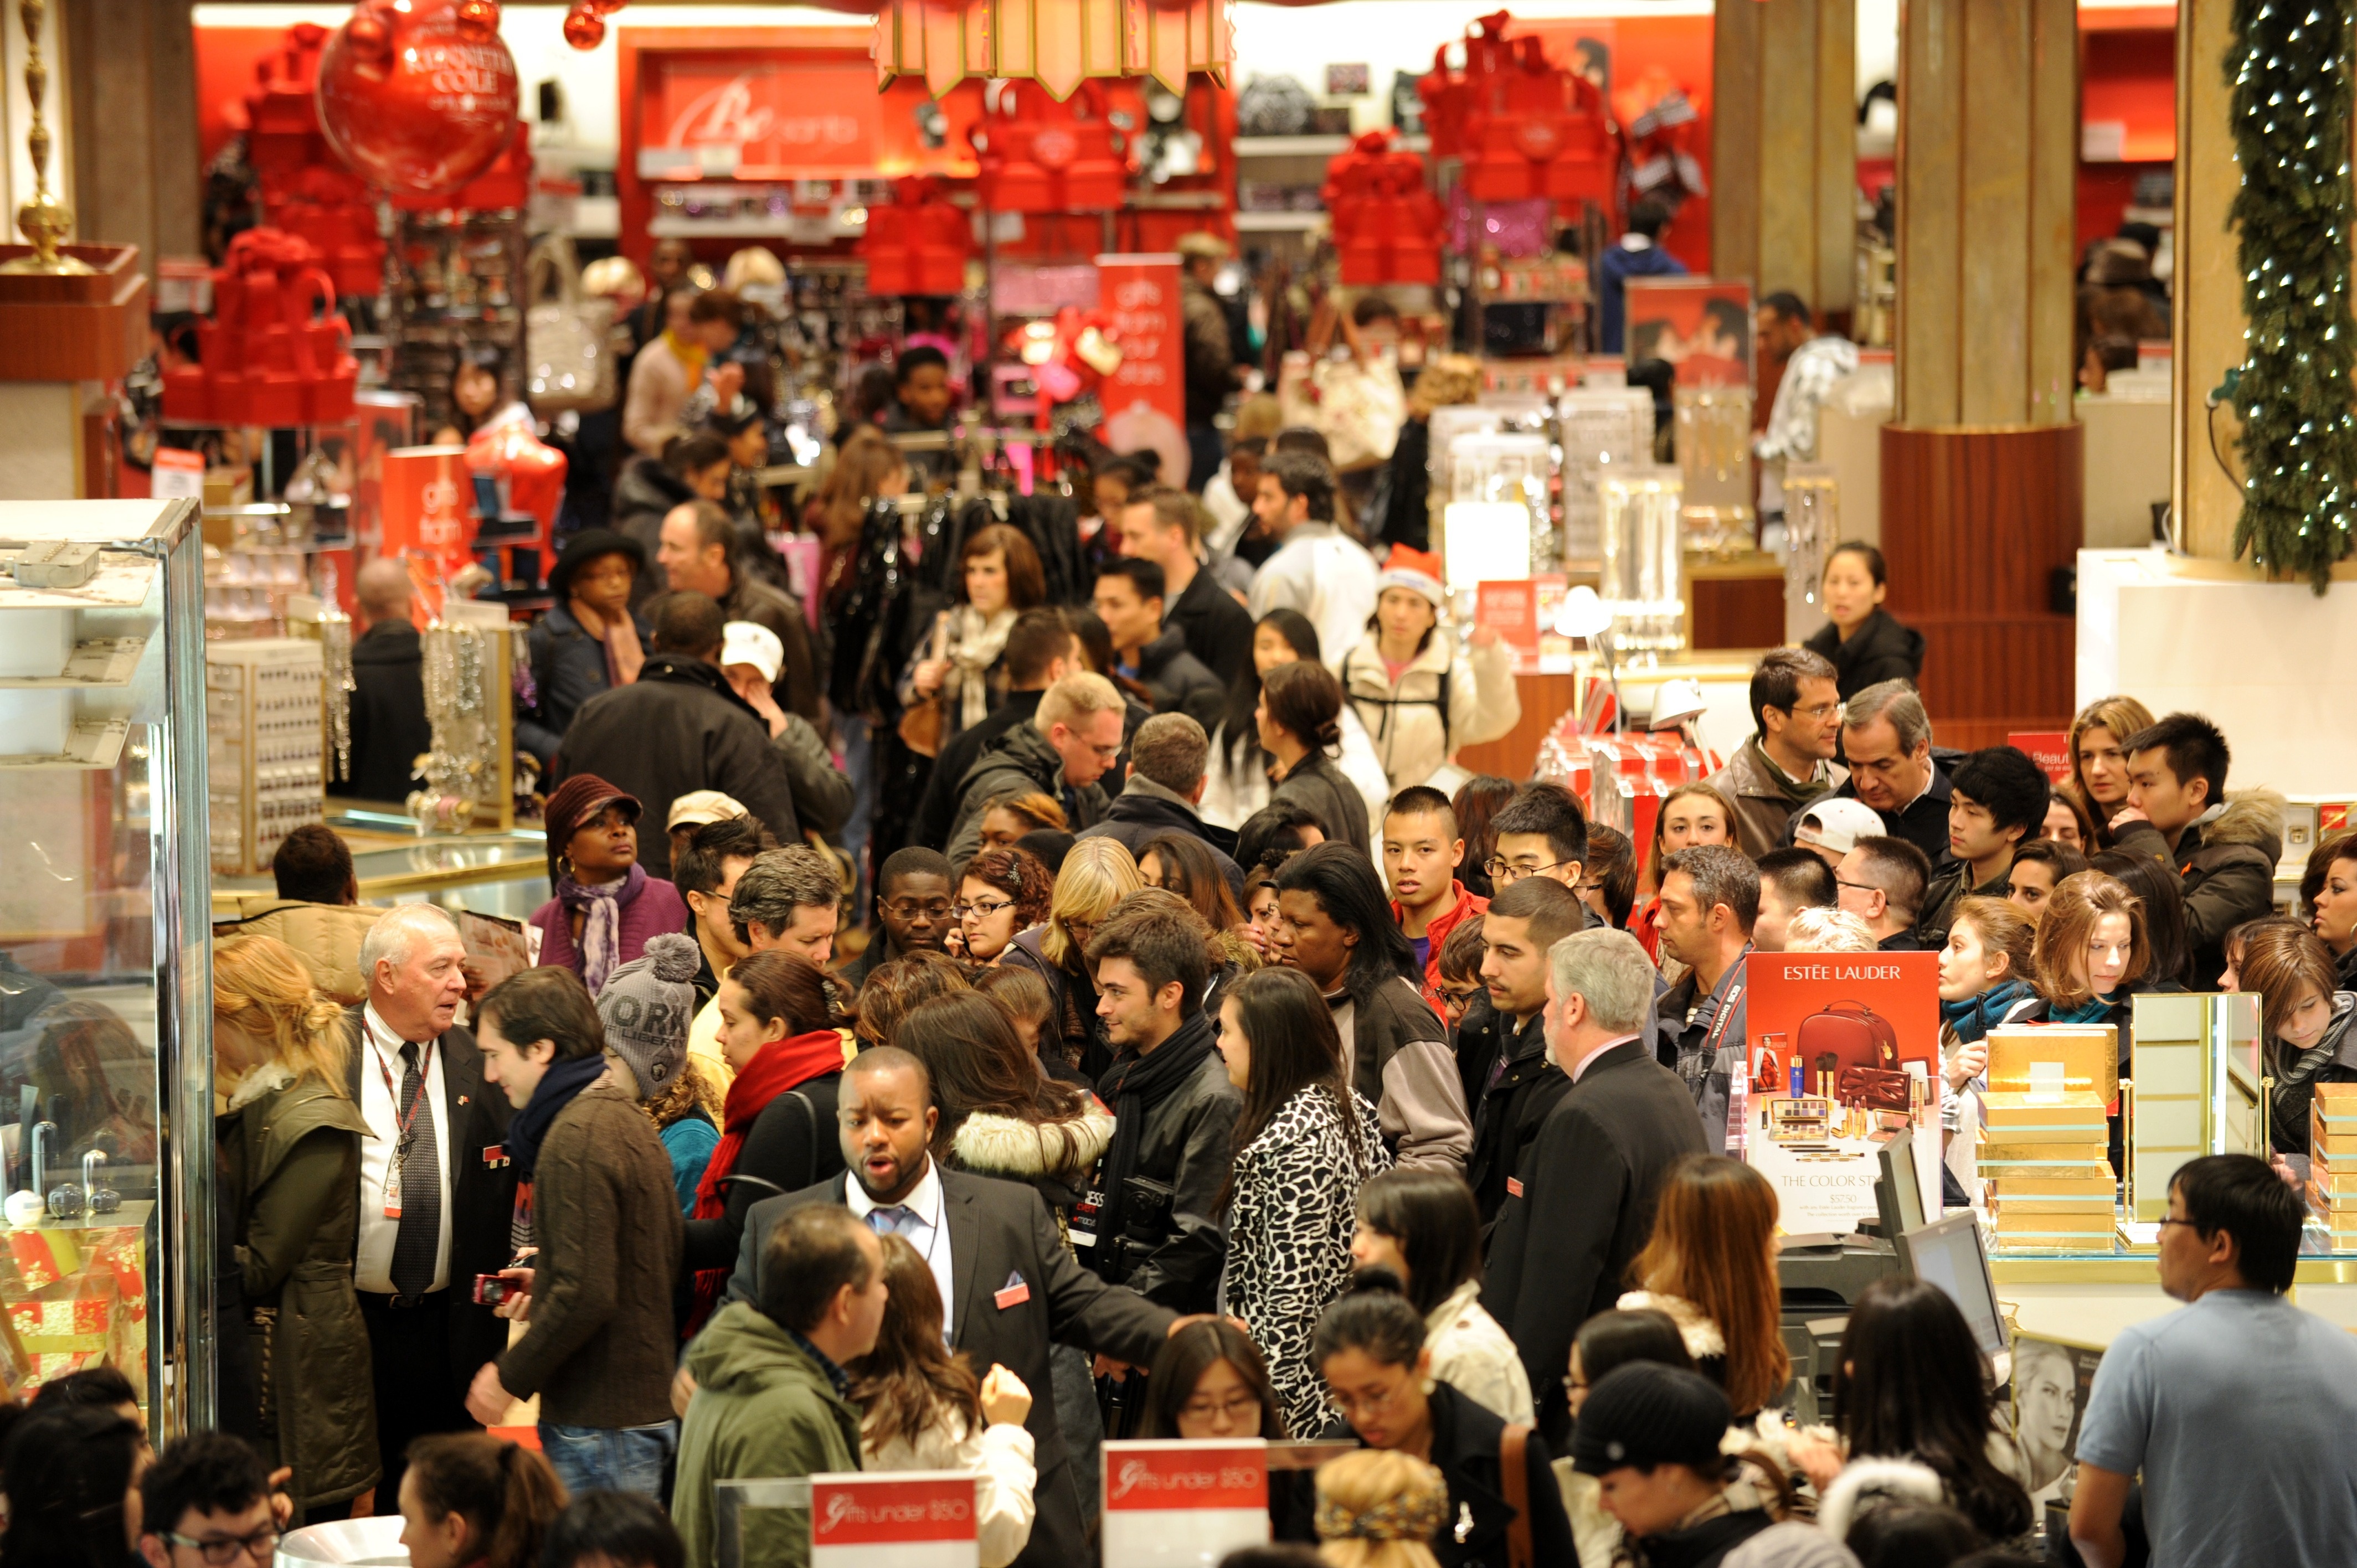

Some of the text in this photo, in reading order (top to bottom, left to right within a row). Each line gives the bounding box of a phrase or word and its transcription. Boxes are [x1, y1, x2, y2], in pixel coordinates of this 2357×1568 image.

[2033, 751, 2069, 764] Beaut
[1835, 966, 1901, 979] LAUDER
[1727, 985, 1741, 1003] EOS
[1711, 1004, 1731, 1039] DIGITAL
[1782, 1175, 1882, 1187] THE COLOR ST
[1085, 1190, 1105, 1207] ESS
